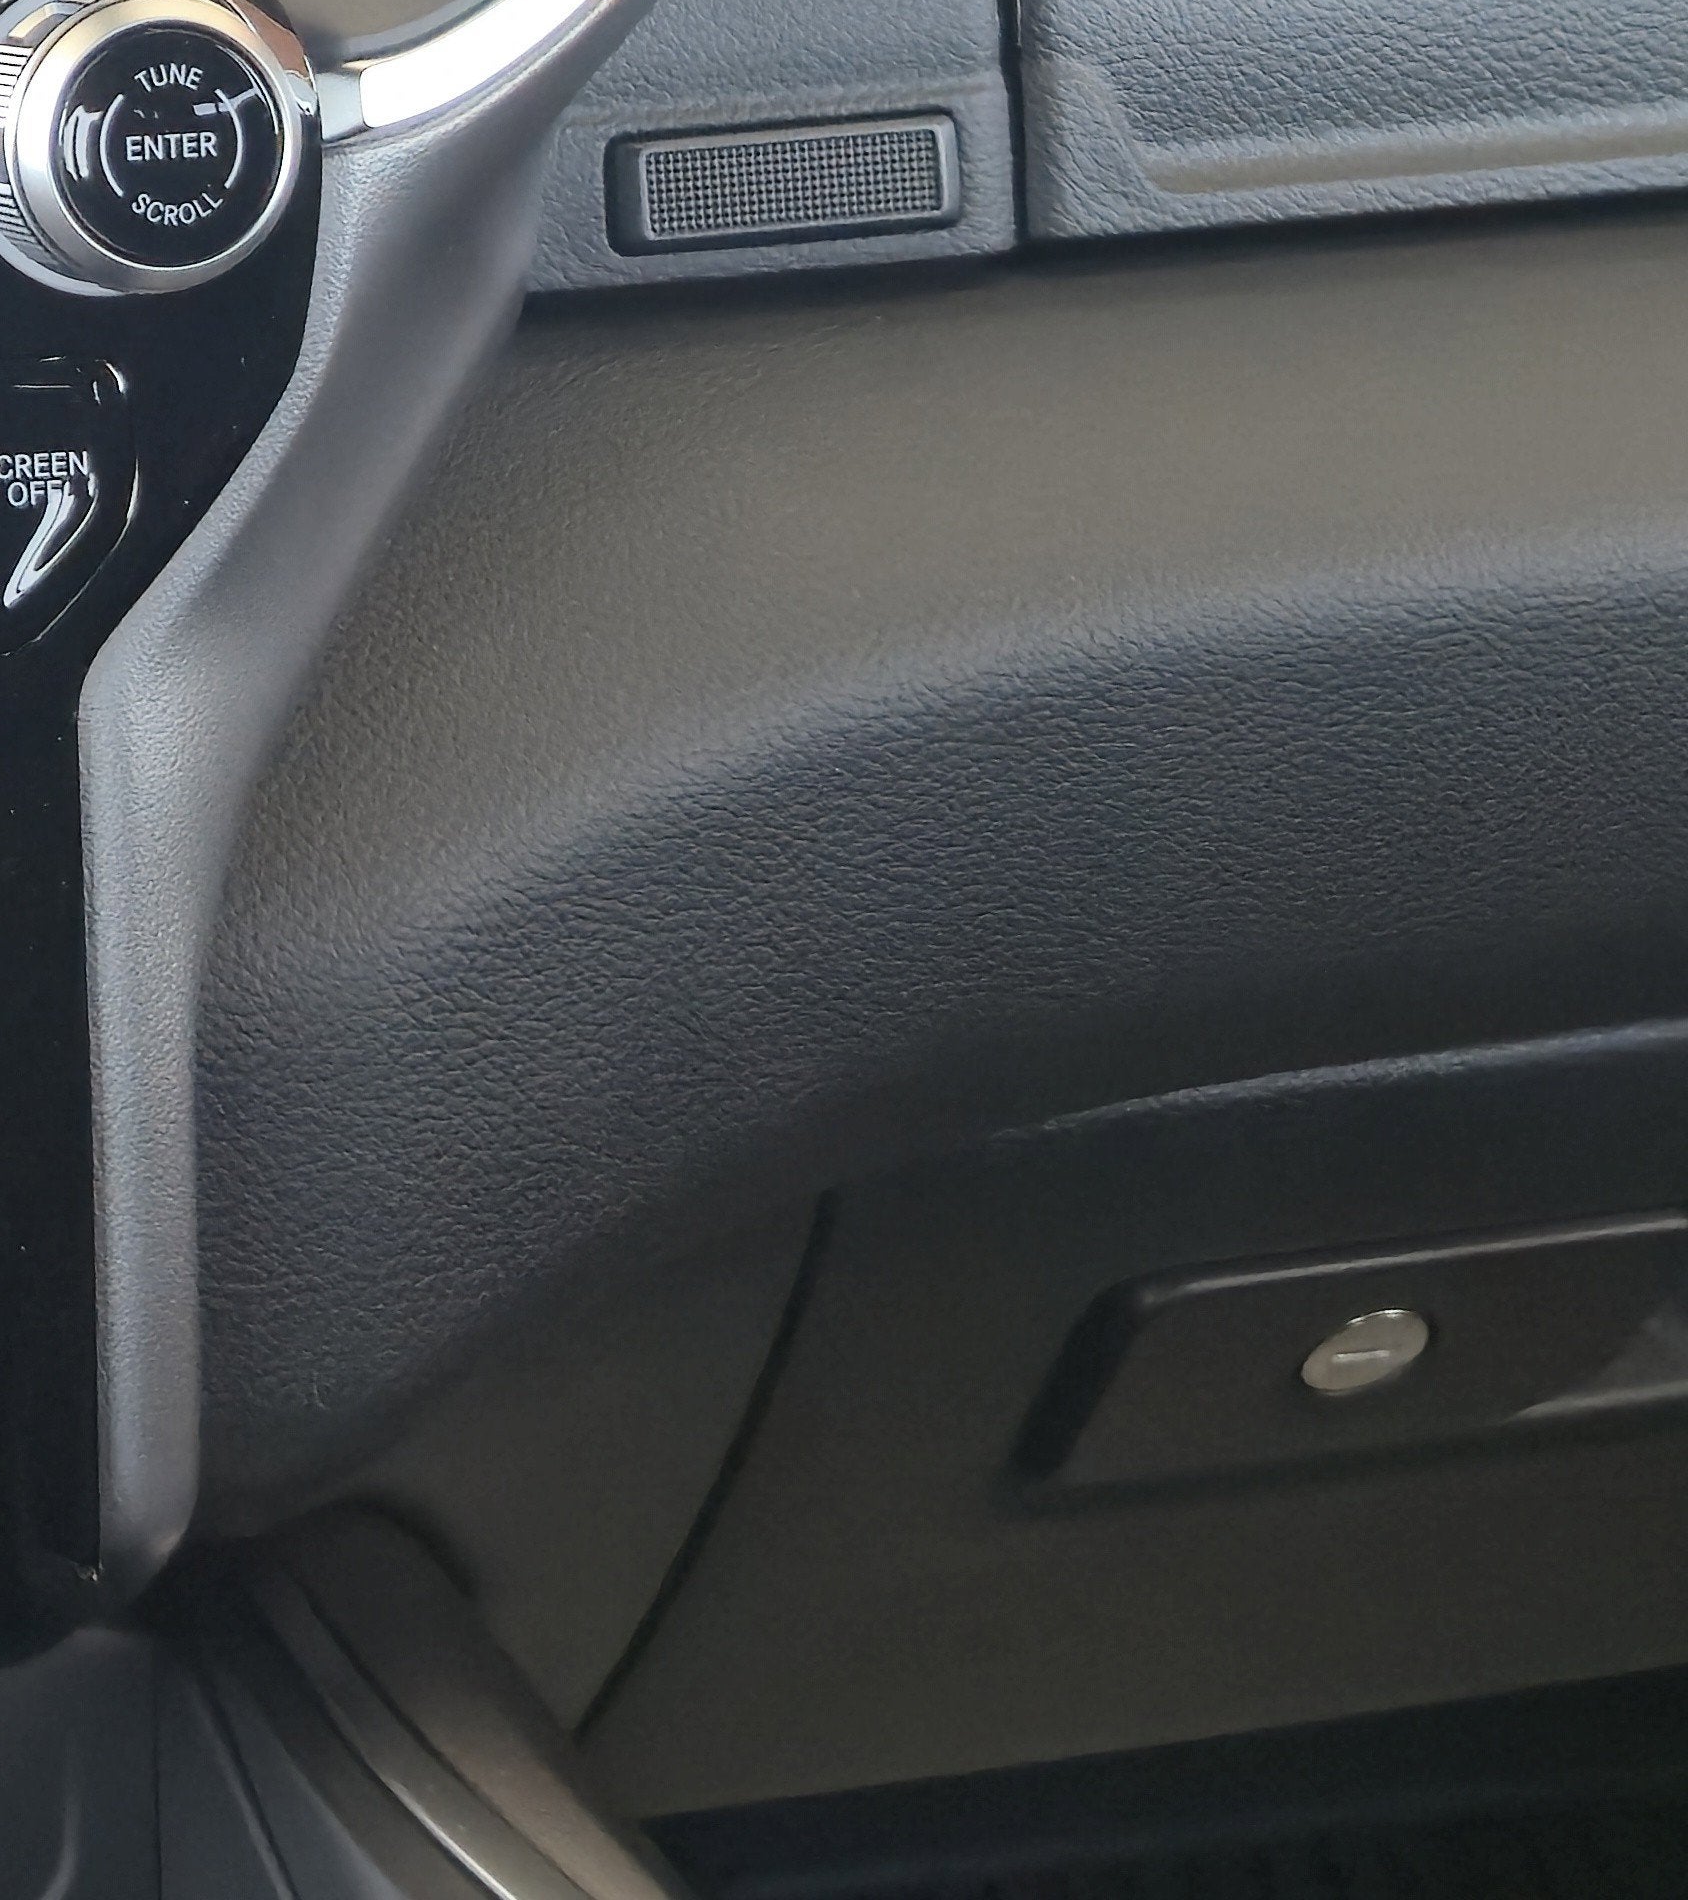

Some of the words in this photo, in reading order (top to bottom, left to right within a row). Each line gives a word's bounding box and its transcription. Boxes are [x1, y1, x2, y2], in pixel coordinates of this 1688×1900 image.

[134, 63, 203, 95] TUNE
[125, 134, 217, 162] ENTER
[131, 193, 224, 227] SCROLL
[7, 479, 62, 507] OFF
